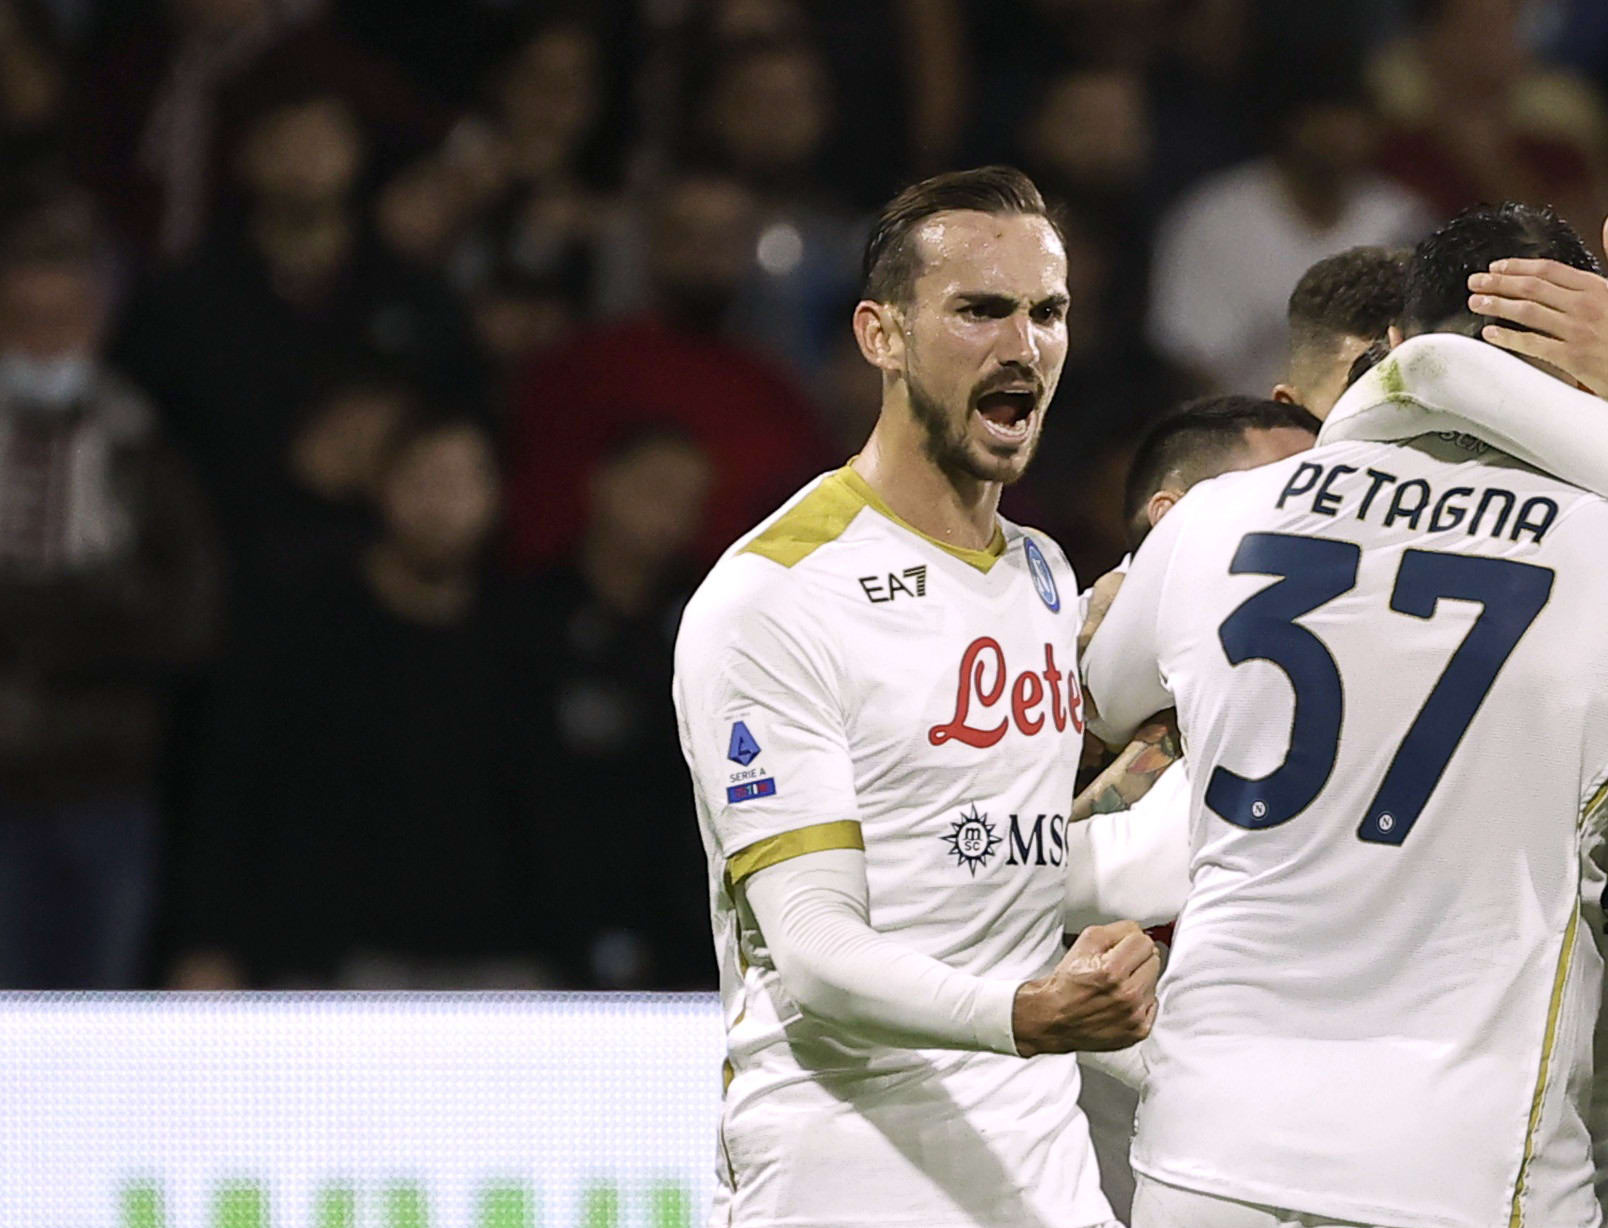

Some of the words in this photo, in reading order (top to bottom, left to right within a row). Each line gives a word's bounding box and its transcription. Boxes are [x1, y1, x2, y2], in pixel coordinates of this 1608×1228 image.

[1275, 461, 1559, 543] PETAGNA
[858, 564, 927, 603] EA7
[1204, 531, 1556, 847] 37
[1004, 813, 1070, 868] MS
